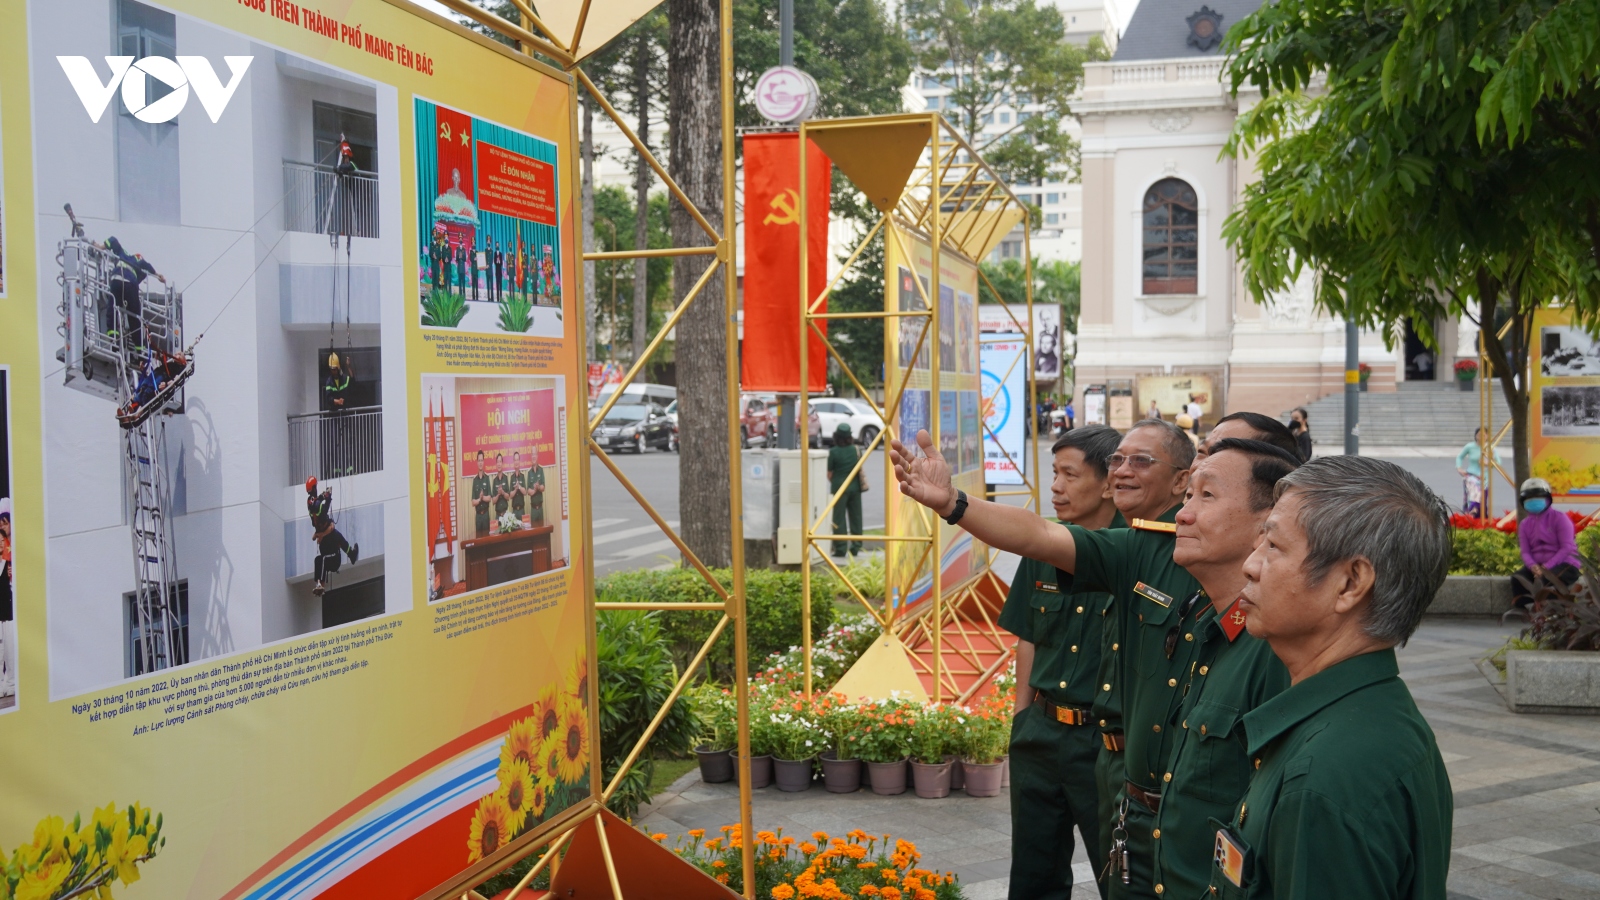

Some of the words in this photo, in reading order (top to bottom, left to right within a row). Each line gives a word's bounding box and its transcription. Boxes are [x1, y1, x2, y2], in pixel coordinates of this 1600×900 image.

[302, 8, 338, 40] THÀNH
[341, 23, 361, 49] PHỐ
[365, 33, 394, 61] MANG
[396, 44, 413, 69] TÊN
[416, 52, 433, 76] BÁC
[500, 162, 506, 174] LỄ
[507, 166, 519, 178] ĐÓN
[520, 171, 535, 182] NHẬN
[488, 408, 505, 429] HỘI
[508, 409, 530, 426] NGHỊ
[72, 702, 91, 715] Ngày
[94, 699, 102, 708] 30
[104, 695, 124, 706] tháng
[126, 690, 134, 700] 10
[136, 687, 150, 697] năm
[152, 682, 168, 692] 2022,
[181, 676, 193, 684] ban
[194, 671, 209, 681] nhân
[210, 668, 221, 676] dân
[223, 662, 241, 673] Thành
[242, 656, 253, 670] phố
[255, 654, 262, 664] Hồ
[263, 653, 272, 662] Chí
[274, 650, 286, 659] Minh
[288, 646, 293, 656] tổ
[294, 645, 307, 654] chức
[308, 640, 319, 650] diễn
[319, 639, 328, 648] tập
[328, 636, 335, 644] xử
[336, 635, 340, 644] lý
[341, 633, 350, 641] tình
[351, 628, 365, 638] huống
[366, 625, 371, 634] về
[90, 711, 101, 722] kết
[103, 709, 118, 720] hợp
[119, 702, 134, 714] diễn
[136, 700, 146, 711] tập
[149, 697, 161, 706] khu
[163, 693, 175, 703] vực
[177, 687, 197, 700] phòng
[211, 678, 229, 690] phòng
[231, 673, 240, 683] thủ
[242, 671, 253, 680] dân
[262, 665, 274, 674] trên
[274, 663, 282, 672] địa
[294, 654, 310, 665] Thành
[311, 650, 320, 662] phố
[322, 649, 332, 657] năm
[333, 645, 344, 654] 2022
[351, 639, 365, 649] Thành
[366, 635, 374, 646] phố
[375, 634, 383, 642] Thủ
[133, 725, 150, 736] Ảnh:
[151, 721, 164, 731] Lực
[166, 715, 185, 726] lượng
[187, 708, 203, 720] Cảnh
[204, 705, 214, 714] sát
[215, 700, 234, 711] Phòng
[235, 696, 250, 705] cháy,
[251, 690, 265, 700] chữa
[266, 686, 279, 696] cháy
[280, 683, 287, 691] và
[288, 680, 299, 689] Cứu
[312, 674, 321, 682] cứu
[322, 671, 329, 679] hộ
[350, 660, 360, 670] diễn
[164, 704, 174, 714] với
[176, 702, 185, 711] sự
[187, 698, 202, 707] tham
[204, 694, 213, 704] gia
[215, 690, 225, 699] của
[226, 688, 238, 696] hơn
[239, 681, 254, 692] 5.000
[255, 676, 272, 688] người
[273, 672, 283, 682] đến
[284, 671, 290, 679] từ
[291, 666, 305, 677] nhiều
[318, 662, 322, 670] vị
[323, 659, 334, 668] khác
